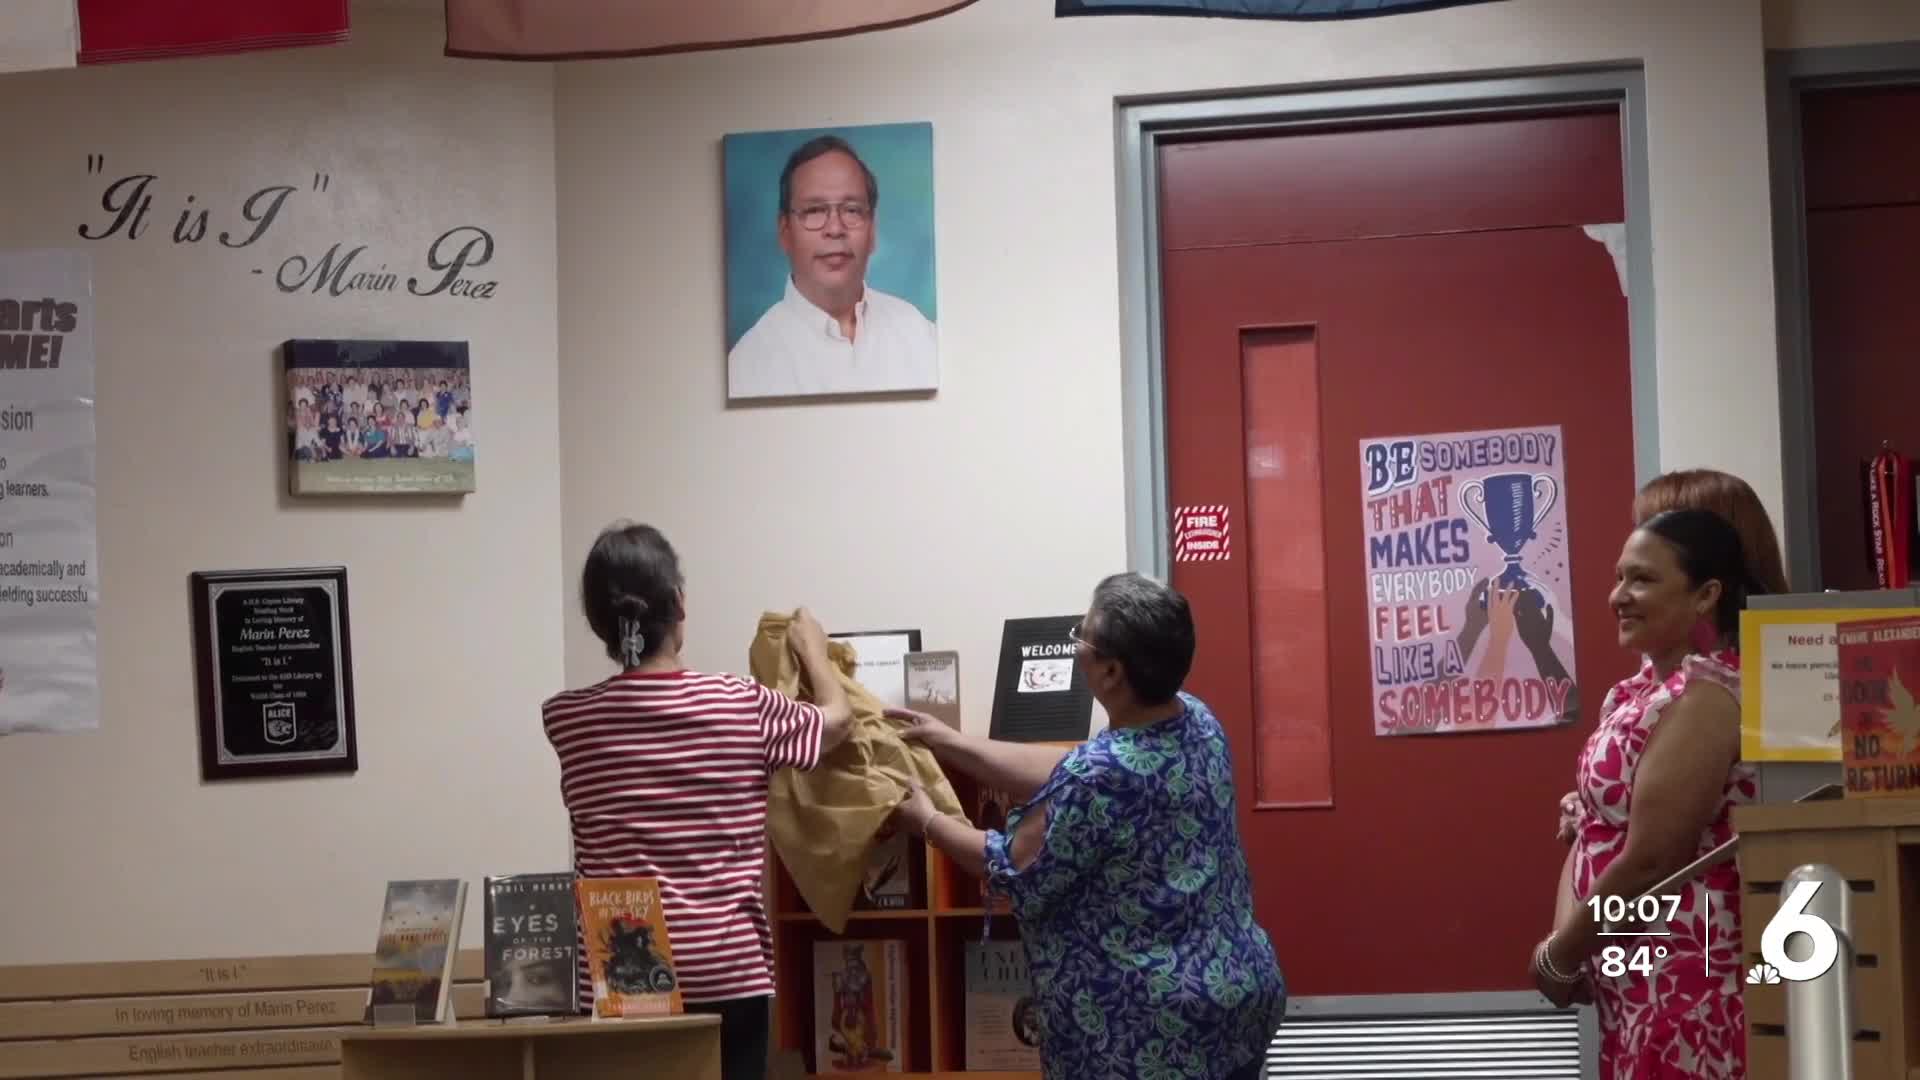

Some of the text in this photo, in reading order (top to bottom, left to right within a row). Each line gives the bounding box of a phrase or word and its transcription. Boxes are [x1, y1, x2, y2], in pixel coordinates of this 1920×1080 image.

[173, 195, 209, 244] is
[275, 242, 399, 297] Marin
[407, 225, 499, 299] Perez
[1365, 433, 1556, 496] BE SOMEBODY
[6, 480, 49, 497] learners.
[1368, 475, 1453, 531] THAT
[1871, 501, 1881, 528] ROCK
[1186, 515, 1218, 529] FIRE
[1370, 518, 1470, 569] MAKES
[67, 560, 86, 577] and
[1371, 567, 1478, 603] EVERYBODY
[240, 626, 310, 641] Marin Perez
[1375, 604, 1450, 641] FEEL
[1021, 643, 1076, 658] WELCOME
[1788, 634, 1824, 647] Need
[1375, 640, 1464, 685] LIKE A
[268, 708, 291, 718] ALICE
[1379, 676, 1571, 729] SOMEBODY
[1855, 735, 1880, 760] NO
[589, 889, 654, 907] BLACK BIRDS
[493, 913, 559, 934] EYES
[503, 945, 572, 961] FOREST
[218, 966, 230, 982] is
[115, 998, 337, 1025] In loving memory of Marin Perez
[129, 1044, 183, 1065] English
